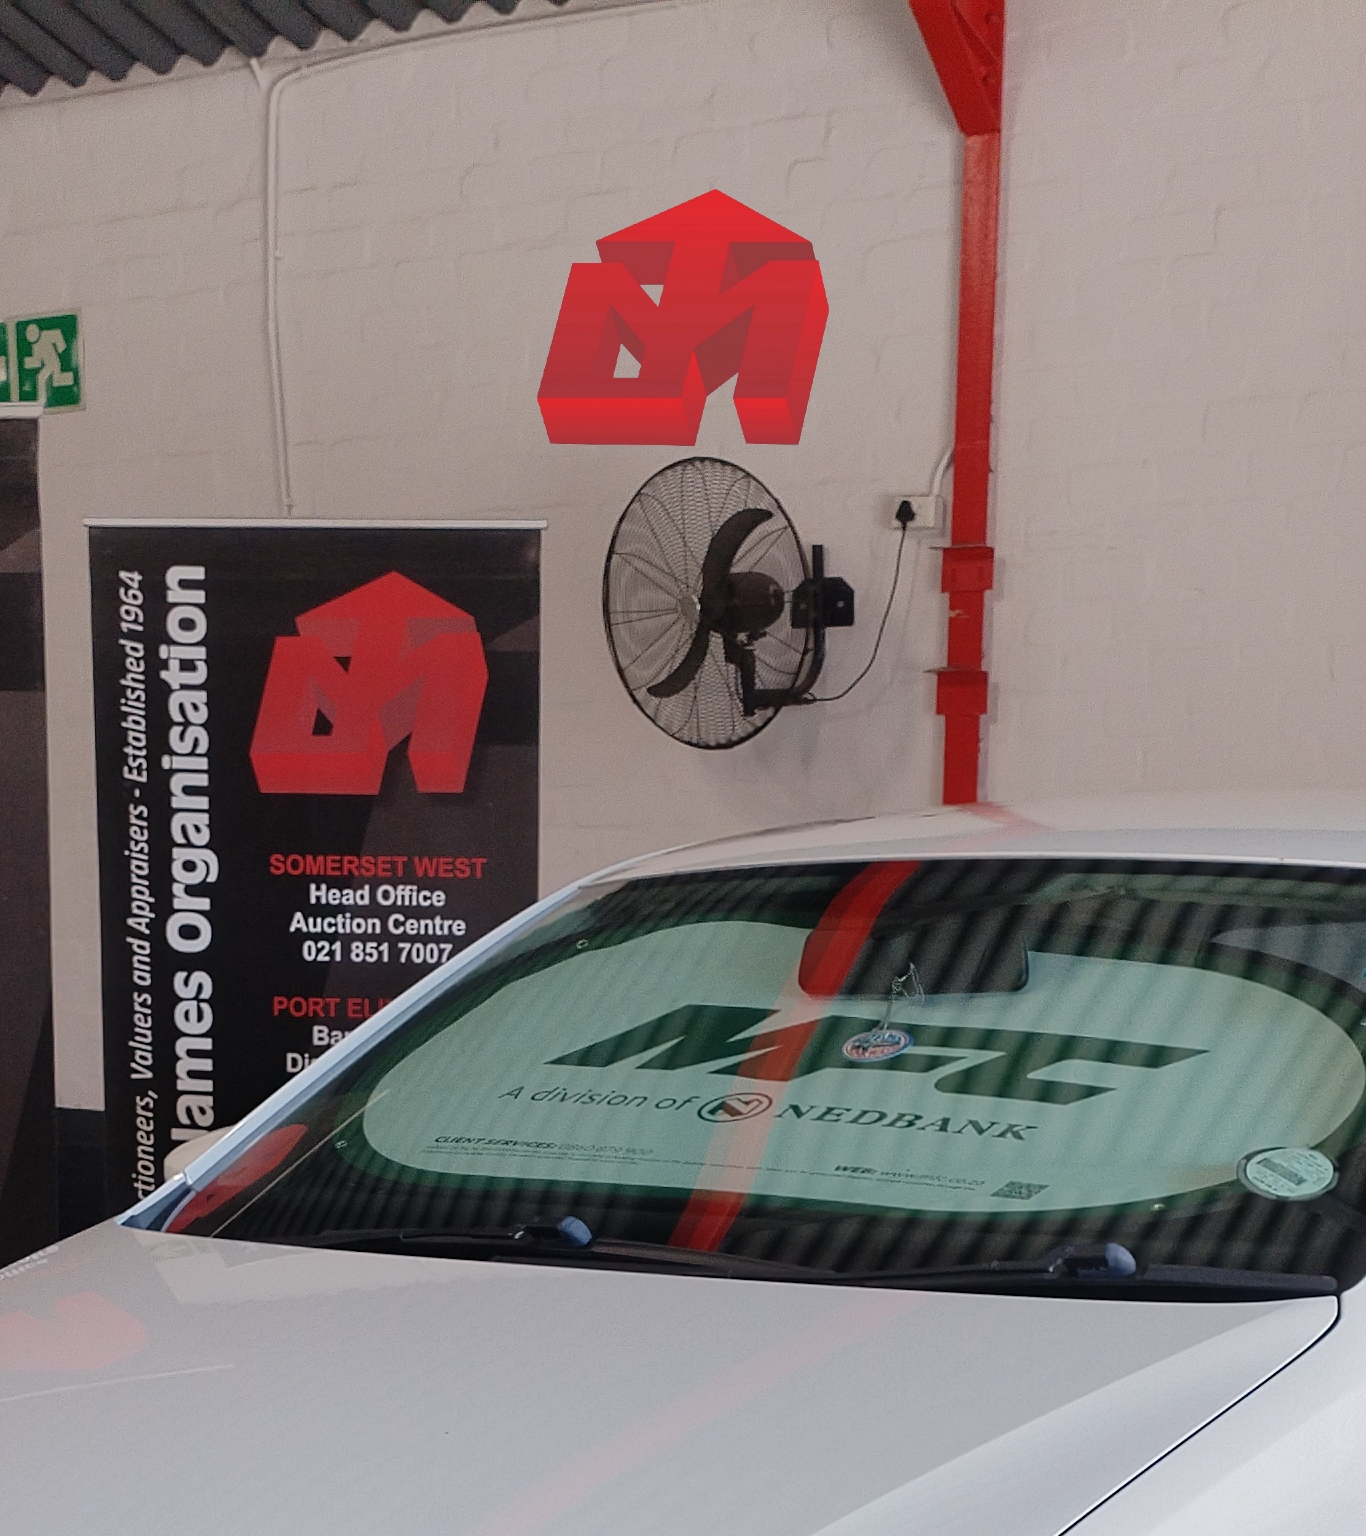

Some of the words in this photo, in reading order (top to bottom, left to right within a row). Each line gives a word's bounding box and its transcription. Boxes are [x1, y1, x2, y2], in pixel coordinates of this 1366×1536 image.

[118, 570, 144, 633] 1964
[119, 639, 148, 783] Established
[159, 565, 219, 953] Organisation
[124, 803, 156, 935] Appraisers
[270, 853, 408, 877] SOMERSET
[413, 857, 486, 878] WEST
[310, 883, 369, 905] Head
[377, 885, 445, 906] Office
[290, 912, 380, 934] Auction
[388, 914, 466, 935] Centre
[127, 937, 152, 986] and
[303, 941, 341, 961] 021
[350, 942, 388, 962] 851
[398, 943, 453, 965] 7007
[273, 996, 340, 1017] PORT
[129, 991, 153, 1079] Valuers
[499, 1086, 525, 1100] A
[531, 1085, 648, 1109] division
[654, 1095, 702, 1112] of
[774, 1102, 1039, 1141] NEDBANK
